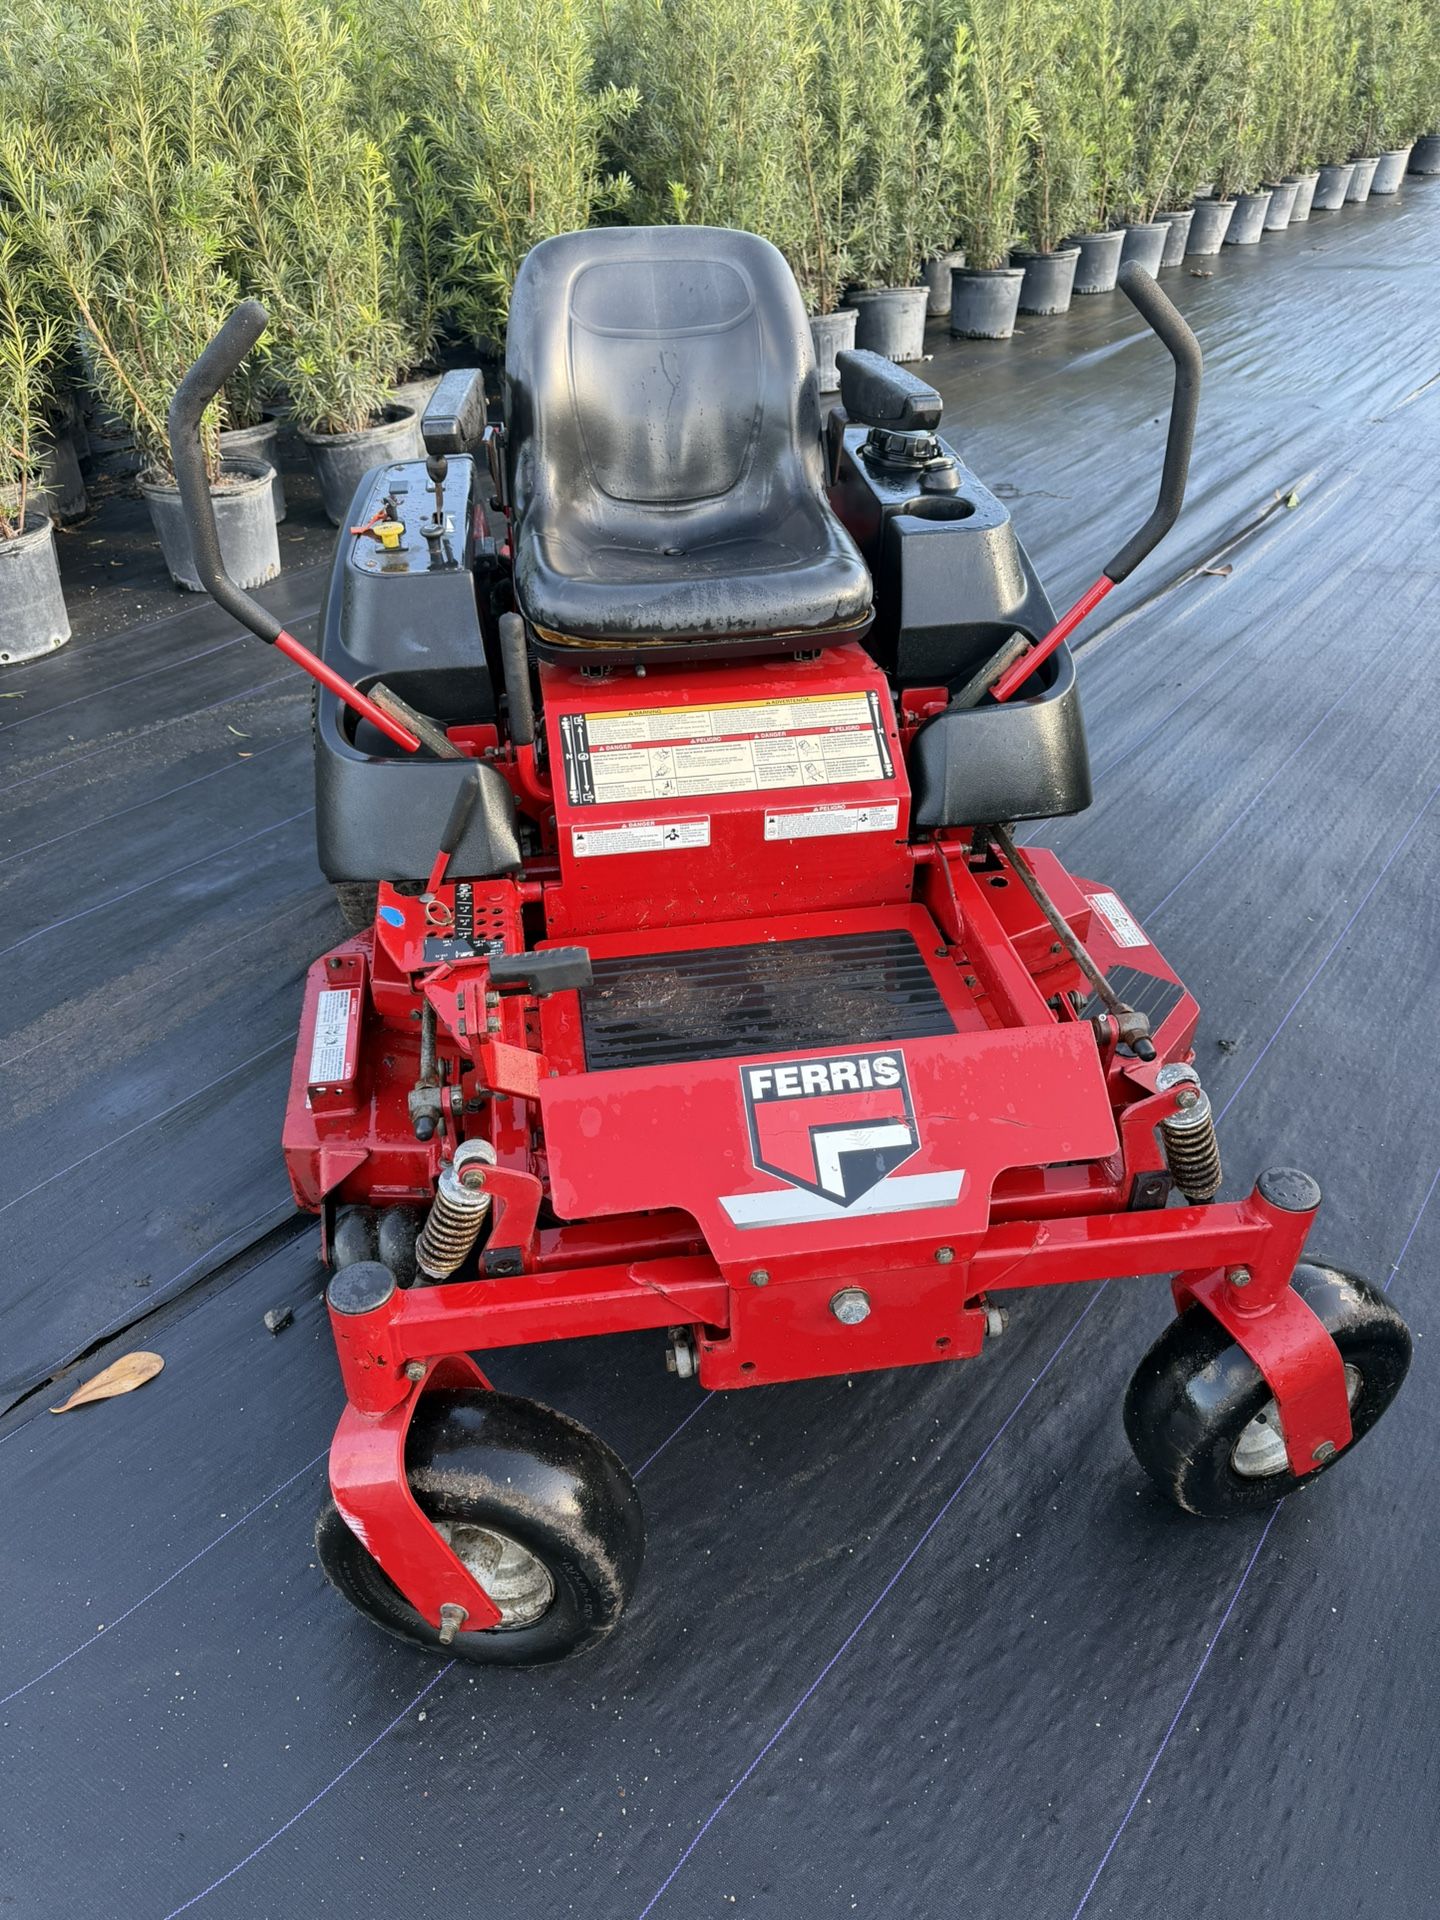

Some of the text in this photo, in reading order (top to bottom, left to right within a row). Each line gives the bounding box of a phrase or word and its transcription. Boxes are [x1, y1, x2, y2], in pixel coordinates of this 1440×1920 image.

[834, 724, 861, 732] PELIGRO
[760, 731, 787, 739] DANGER
[695, 736, 722, 744] PELIGRO
[605, 743, 633, 751] DANGER
[749, 1056, 901, 1100] FERRIS
